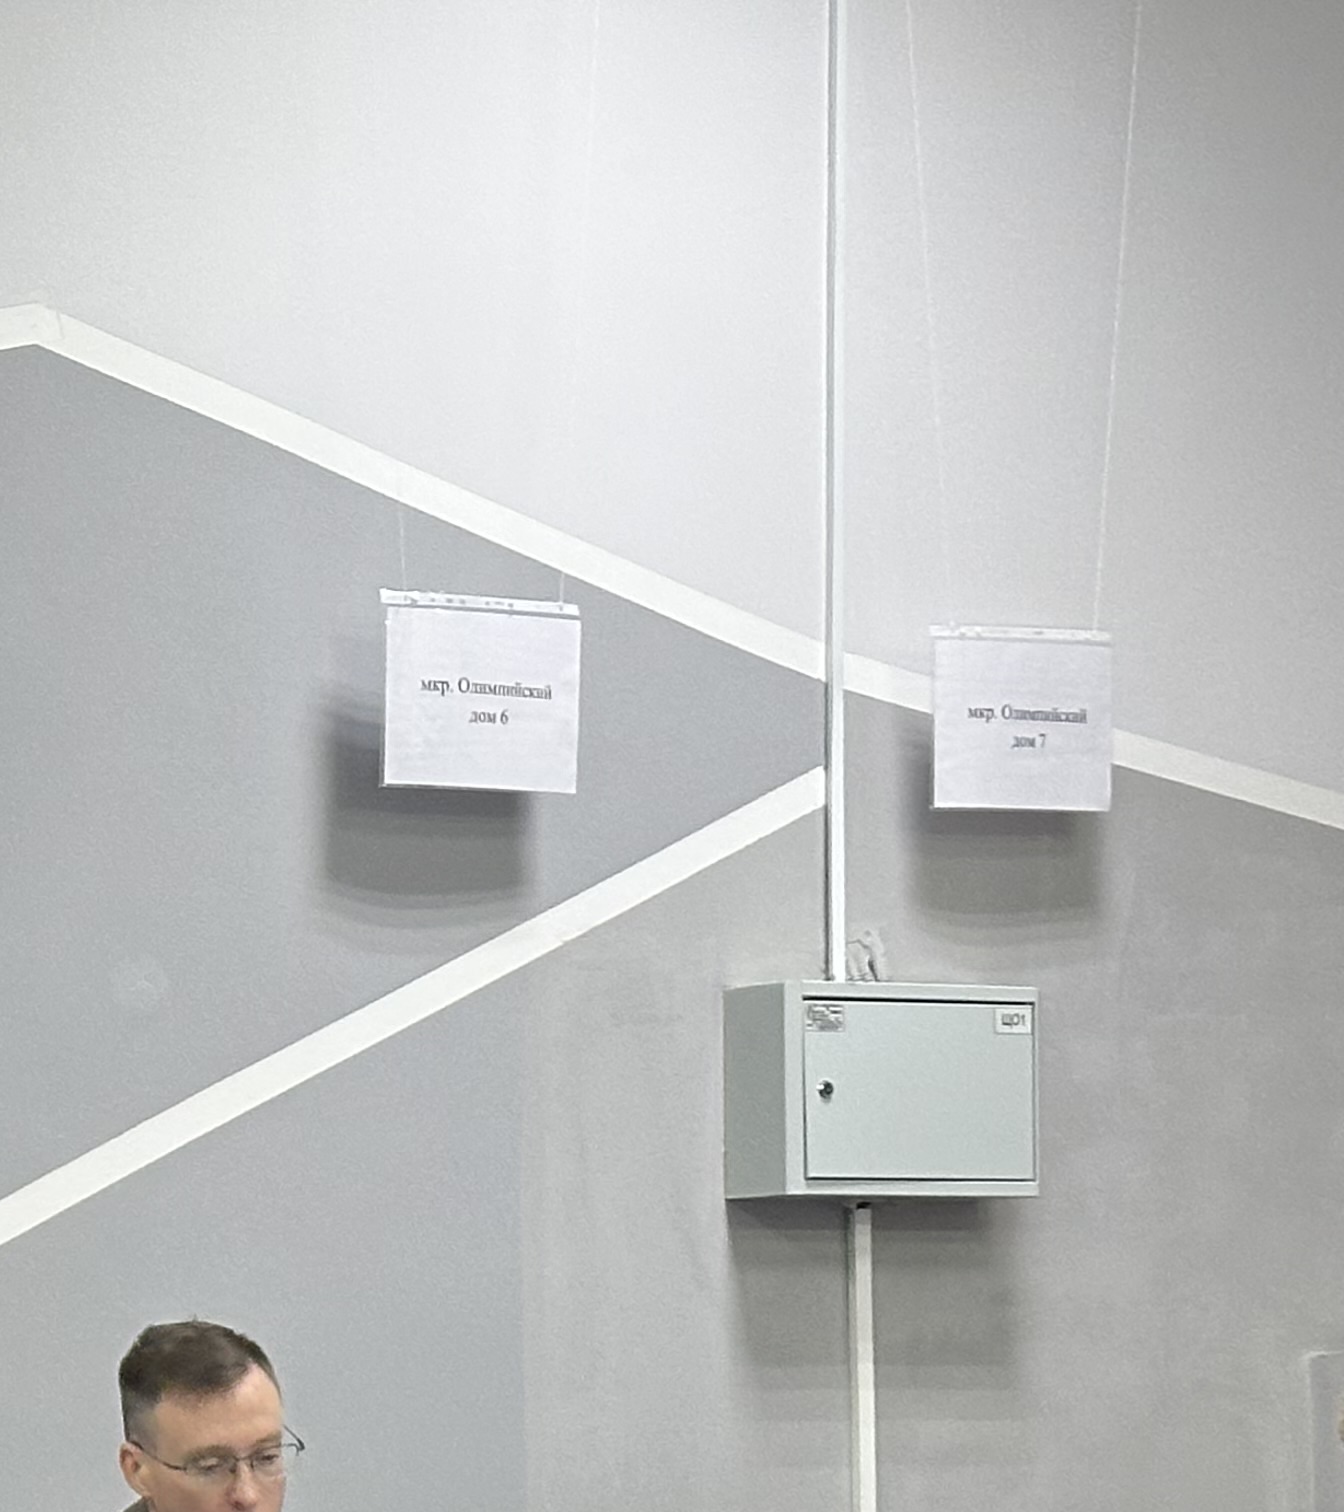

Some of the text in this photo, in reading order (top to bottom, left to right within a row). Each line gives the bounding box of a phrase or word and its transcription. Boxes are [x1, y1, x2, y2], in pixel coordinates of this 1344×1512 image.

[421, 677, 552, 700] мкр. Олимпийский
[468, 709, 509, 725] дом 6
[967, 706, 997, 723] мкр.
[1011, 733, 1047, 750] дом 7
